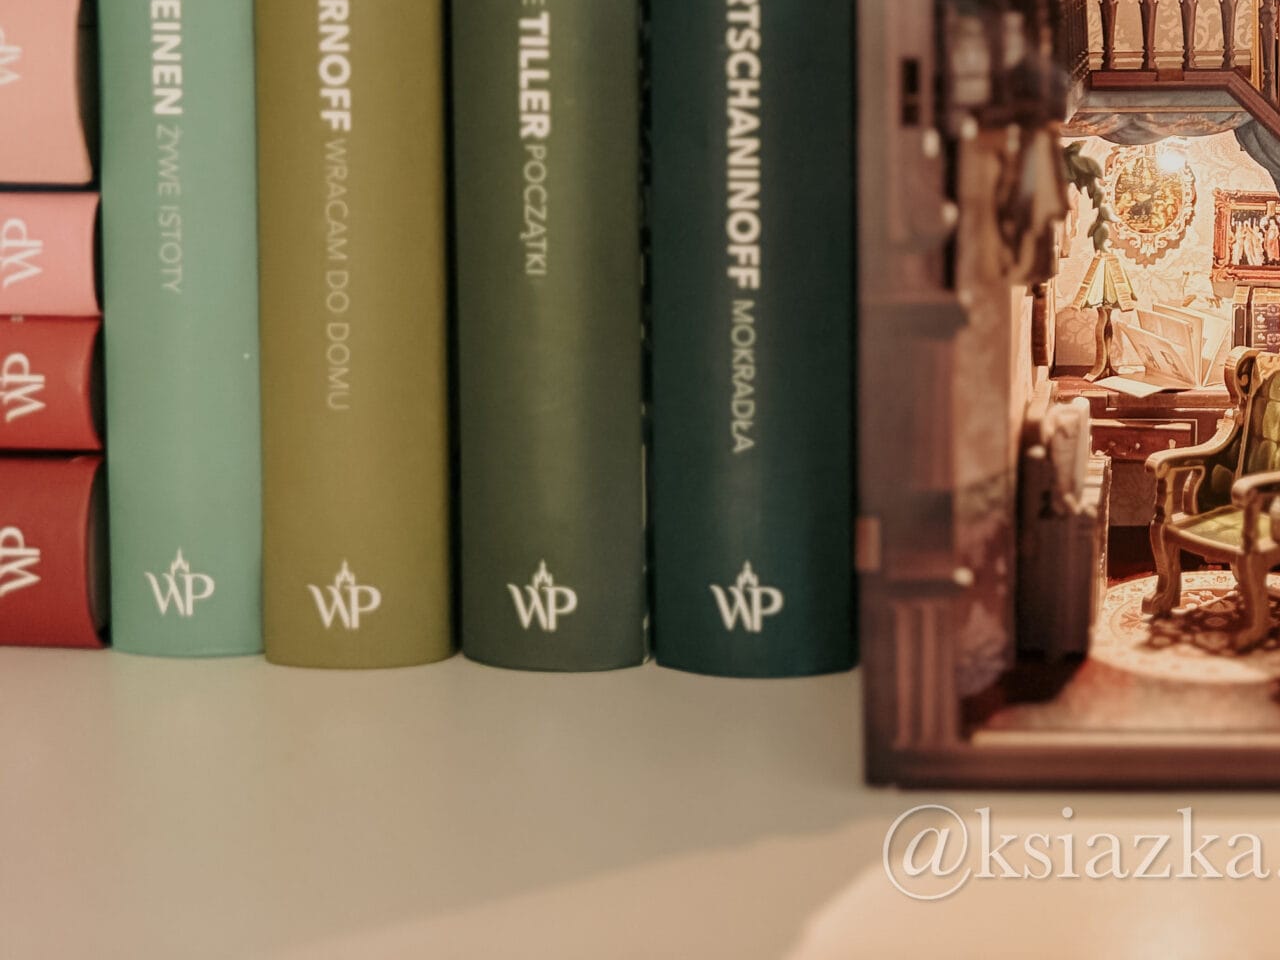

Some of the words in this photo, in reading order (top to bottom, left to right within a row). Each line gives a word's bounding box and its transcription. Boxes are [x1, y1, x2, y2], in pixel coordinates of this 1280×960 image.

[518, 11, 551, 139] TILLER
[155, 123, 183, 197] ŻYWE
[325, 138, 350, 261] WRACAM
[520, 144, 547, 276] POCZĄTKI
[2, 218, 43, 288] WP
[158, 205, 184, 294] ISTOTY
[325, 269, 350, 313] DO
[1, 352, 46, 423] WP
[326, 321, 351, 410] DOMU
[730, 299, 757, 453] MOKRADŁA
[145, 564, 216, 619] WP
[307, 574, 382, 631] WP
[507, 573, 580, 633] WP
[709, 573, 785, 634] WP
